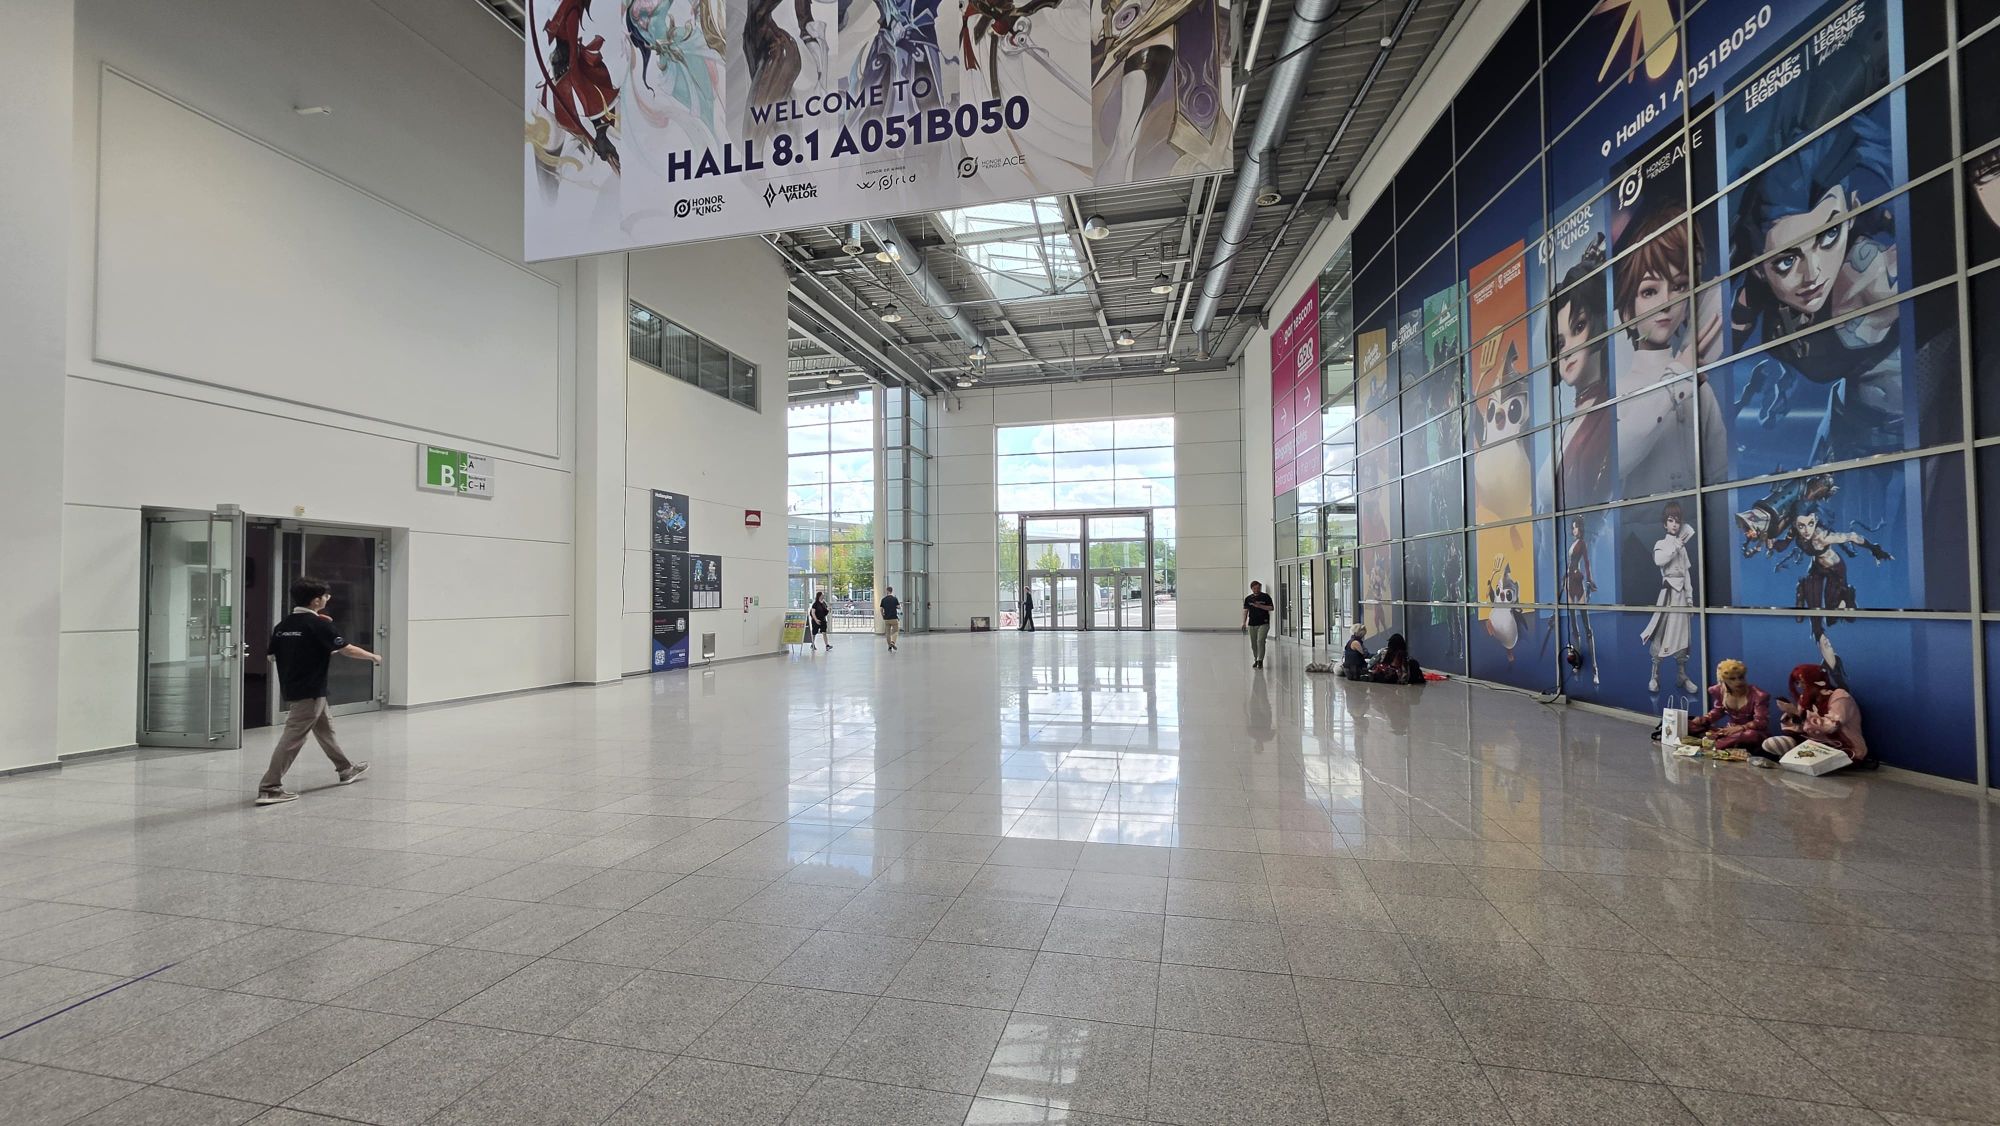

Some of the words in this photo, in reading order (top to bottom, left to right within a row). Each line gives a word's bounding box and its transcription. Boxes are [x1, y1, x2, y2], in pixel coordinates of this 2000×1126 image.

[1814, 5, 1858, 45] LEAGUE
[1814, 10, 1865, 55] LEGENDS
[1616, 92, 1667, 148] Hall8.1
[1672, 4, 1772, 102] A051B050
[1744, 56, 1793, 101] LEAGUE
[1744, 64, 1802, 113] LEGENDS
[750, 85, 884, 126] WELCOME
[892, 76, 932, 102] TO
[667, 139, 764, 183] HALL
[772, 128, 819, 167] 8.1
[830, 95, 1030, 159] A051B050
[982, 157, 1002, 165] HONOR
[1002, 155, 1026, 167] ACE
[1646, 152, 1671, 175] HONOR
[1650, 161, 1671, 180] KINGS
[778, 182, 813, 194] ARENA
[784, 189, 818, 203] VALOR
[692, 195, 725, 207] HONOR
[695, 204, 722, 217] KINGS
[1556, 206, 1594, 240] HONOR
[1560, 220, 1591, 251] KINGS
[441, 464, 456, 487] B
[468, 460, 475, 469] A
